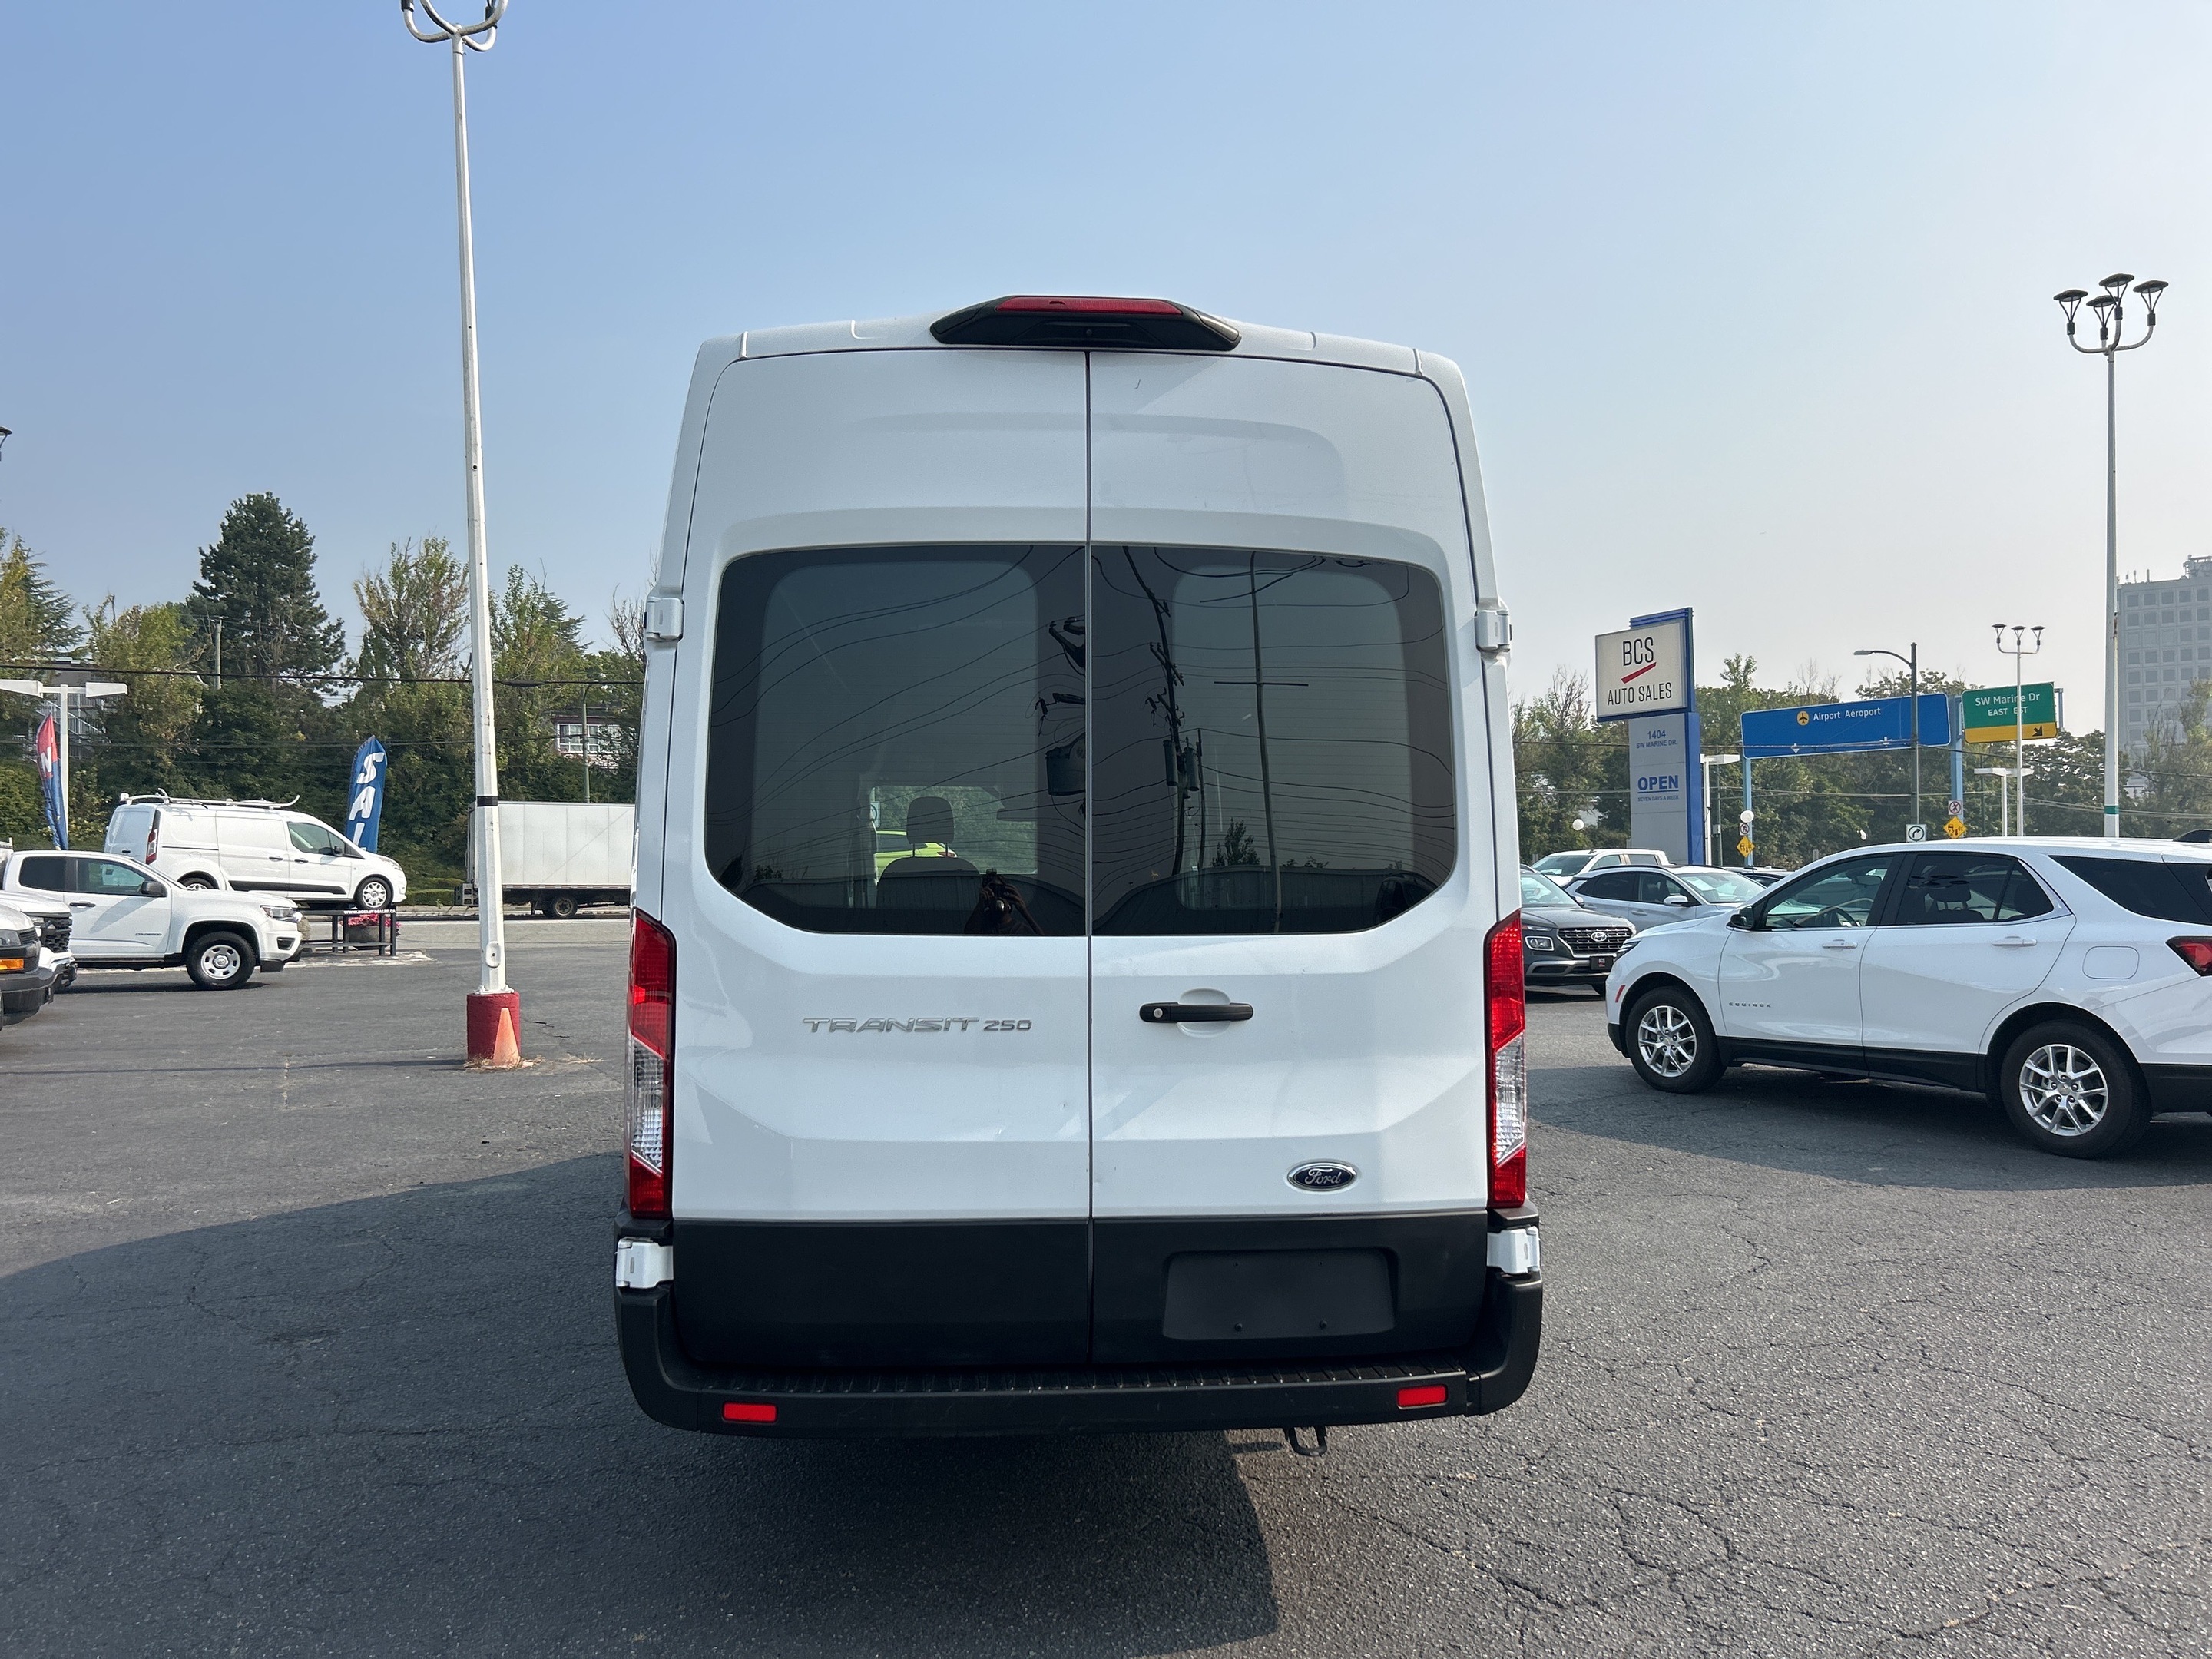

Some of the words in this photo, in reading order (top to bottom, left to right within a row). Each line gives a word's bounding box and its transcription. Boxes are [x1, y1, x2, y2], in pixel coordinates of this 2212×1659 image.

[1623, 637, 1654, 666] BCS
[1608, 687, 1634, 706] AUTO
[1638, 682, 1672, 702] SALES
[1975, 697, 1990, 707] SW
[1993, 694, 2025, 704] Marine
[2028, 693, 2040, 701] Dr
[1813, 711, 1841, 722] Airport
[1845, 707, 1881, 719] Aéroport
[1988, 708, 2008, 717] EAST
[1647, 730, 1666, 740] 1404
[1646, 740, 1667, 748] MARINE
[1637, 775, 1679, 790] OPEN
[349, 752, 385, 851] SAL
[803, 1018, 979, 1033] TRANSIT
[983, 1019, 1032, 1031] 250
[1305, 1168, 1342, 1184] Ford
